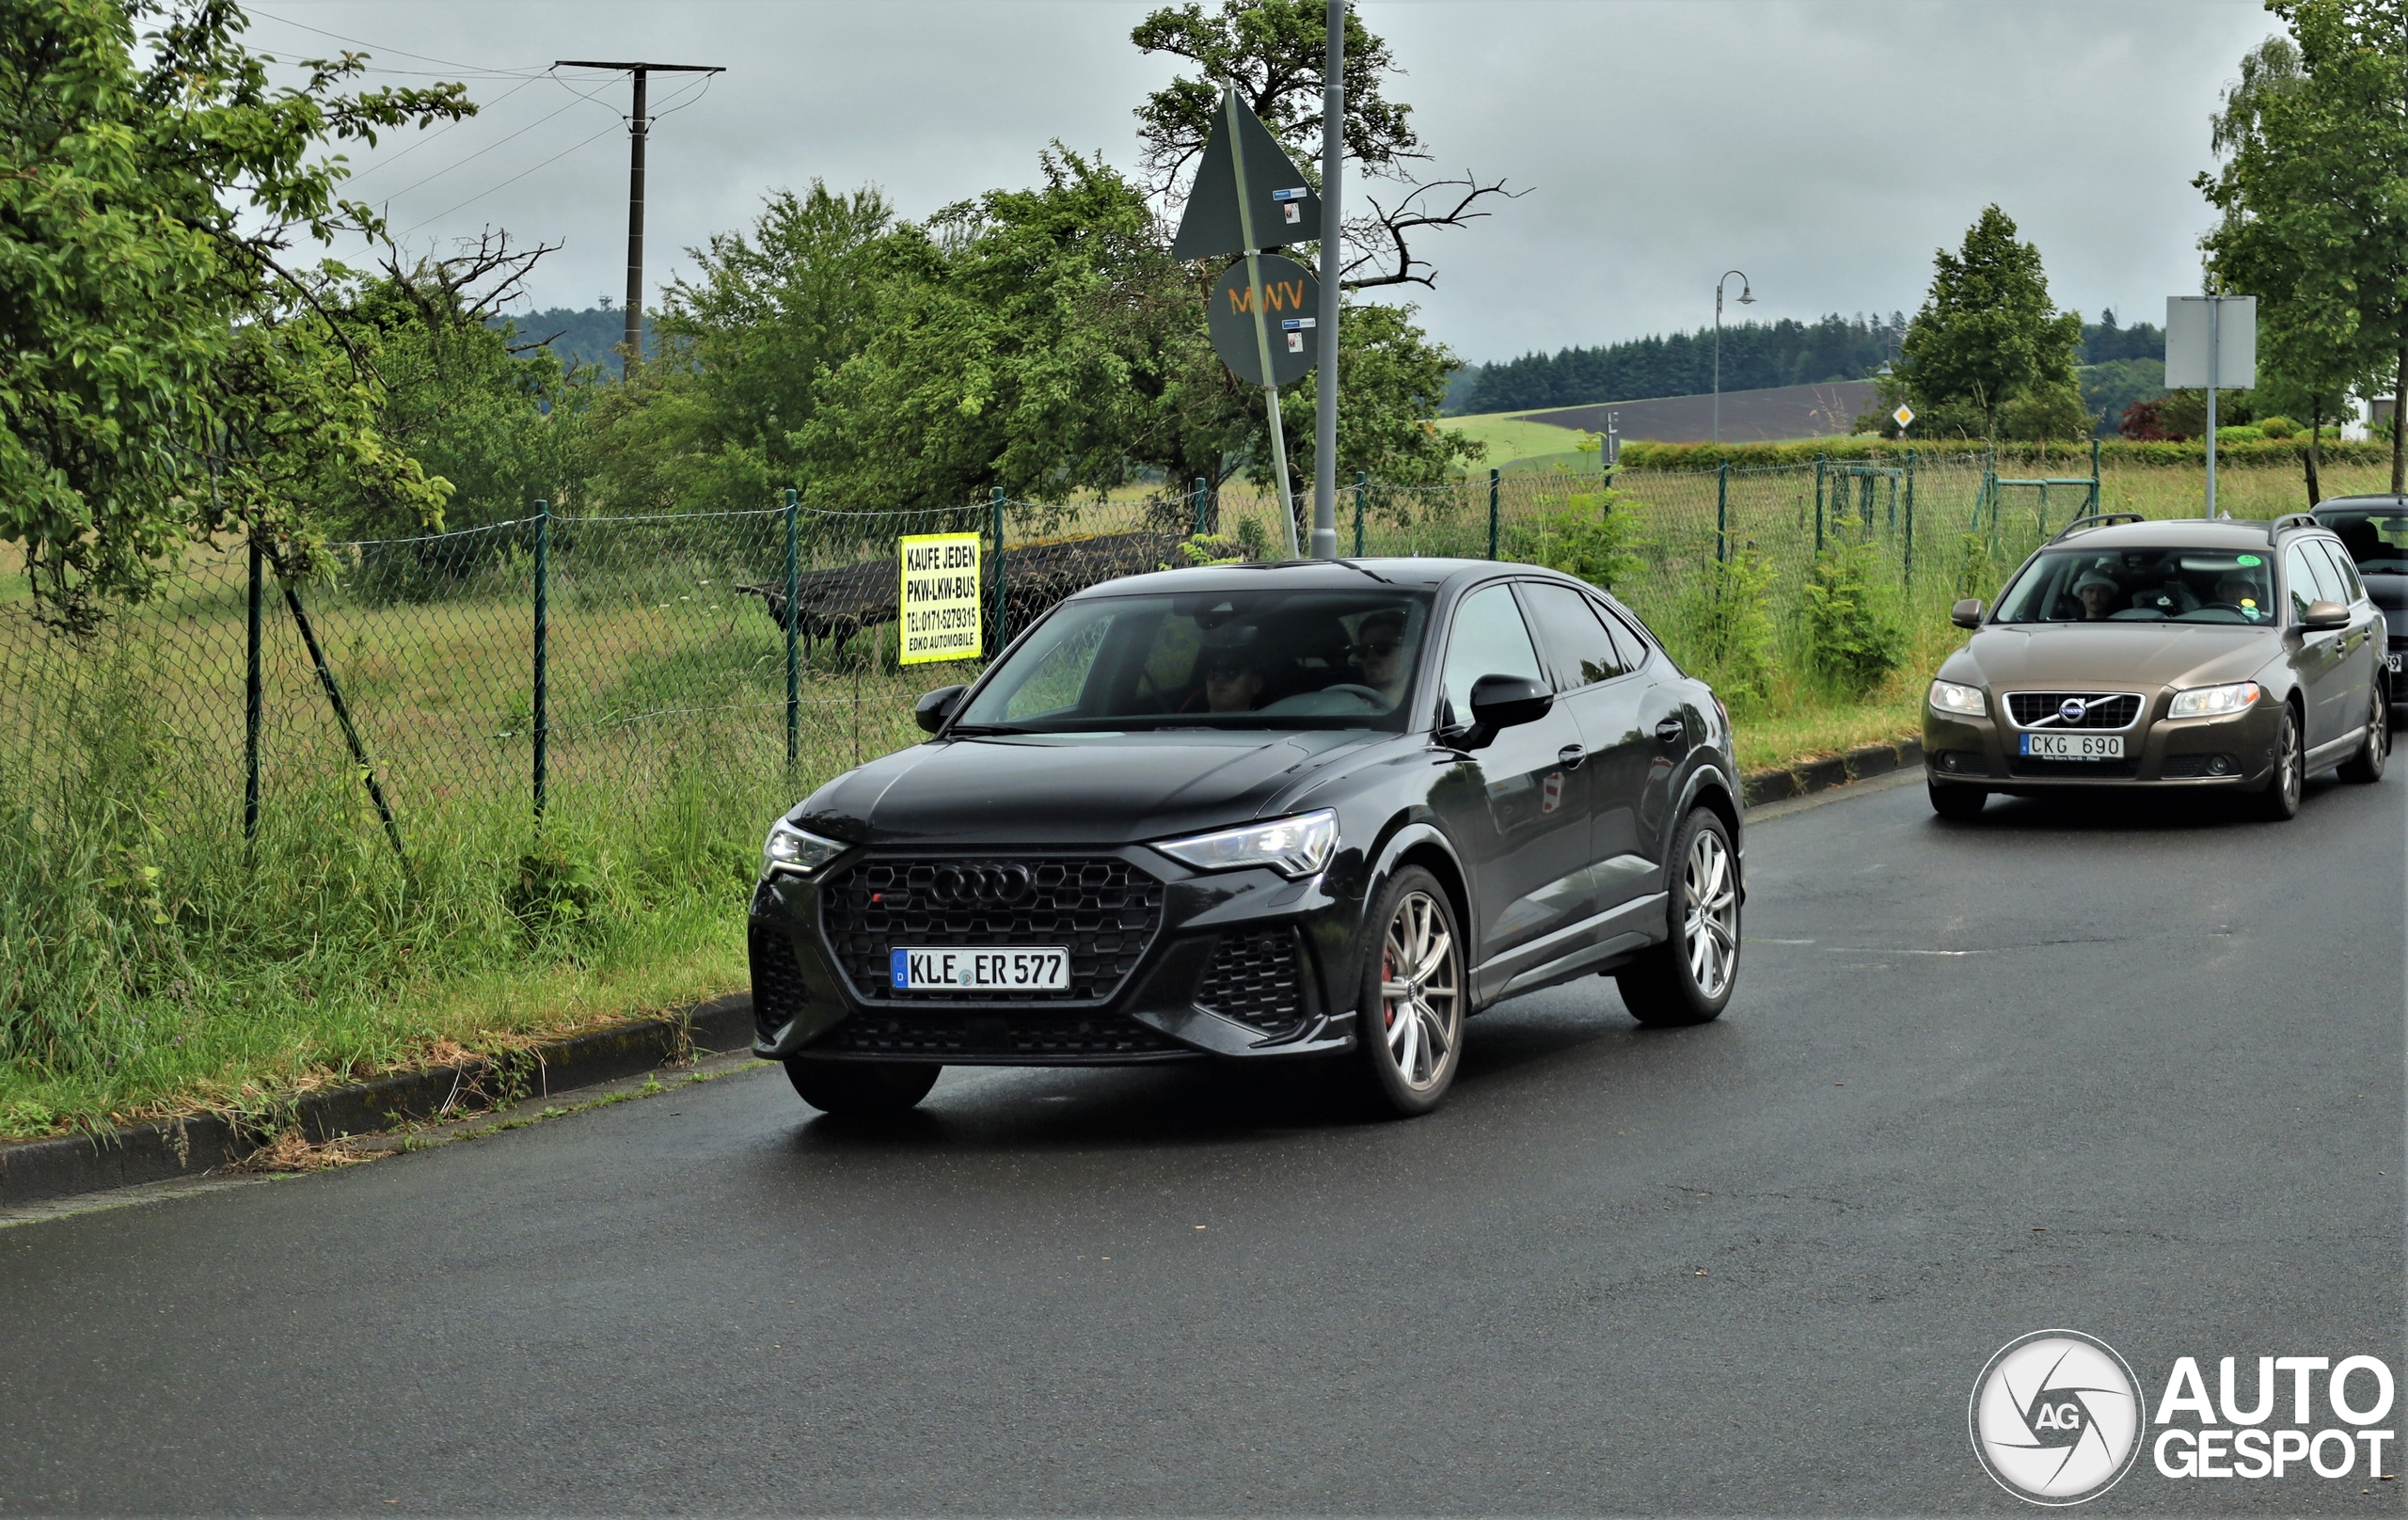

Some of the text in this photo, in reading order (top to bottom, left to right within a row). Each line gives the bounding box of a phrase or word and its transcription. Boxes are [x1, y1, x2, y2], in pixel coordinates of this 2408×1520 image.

[908, 546, 975, 572] KAUFE JEDEN
[908, 576, 975, 603] PKW-LKW-BUS
[909, 632, 974, 651] EDKO AUTOMOBILE
[2032, 736, 2119, 754] CKG 690
[896, 972, 904, 981] D
[911, 955, 1062, 984] KLE ER 577
